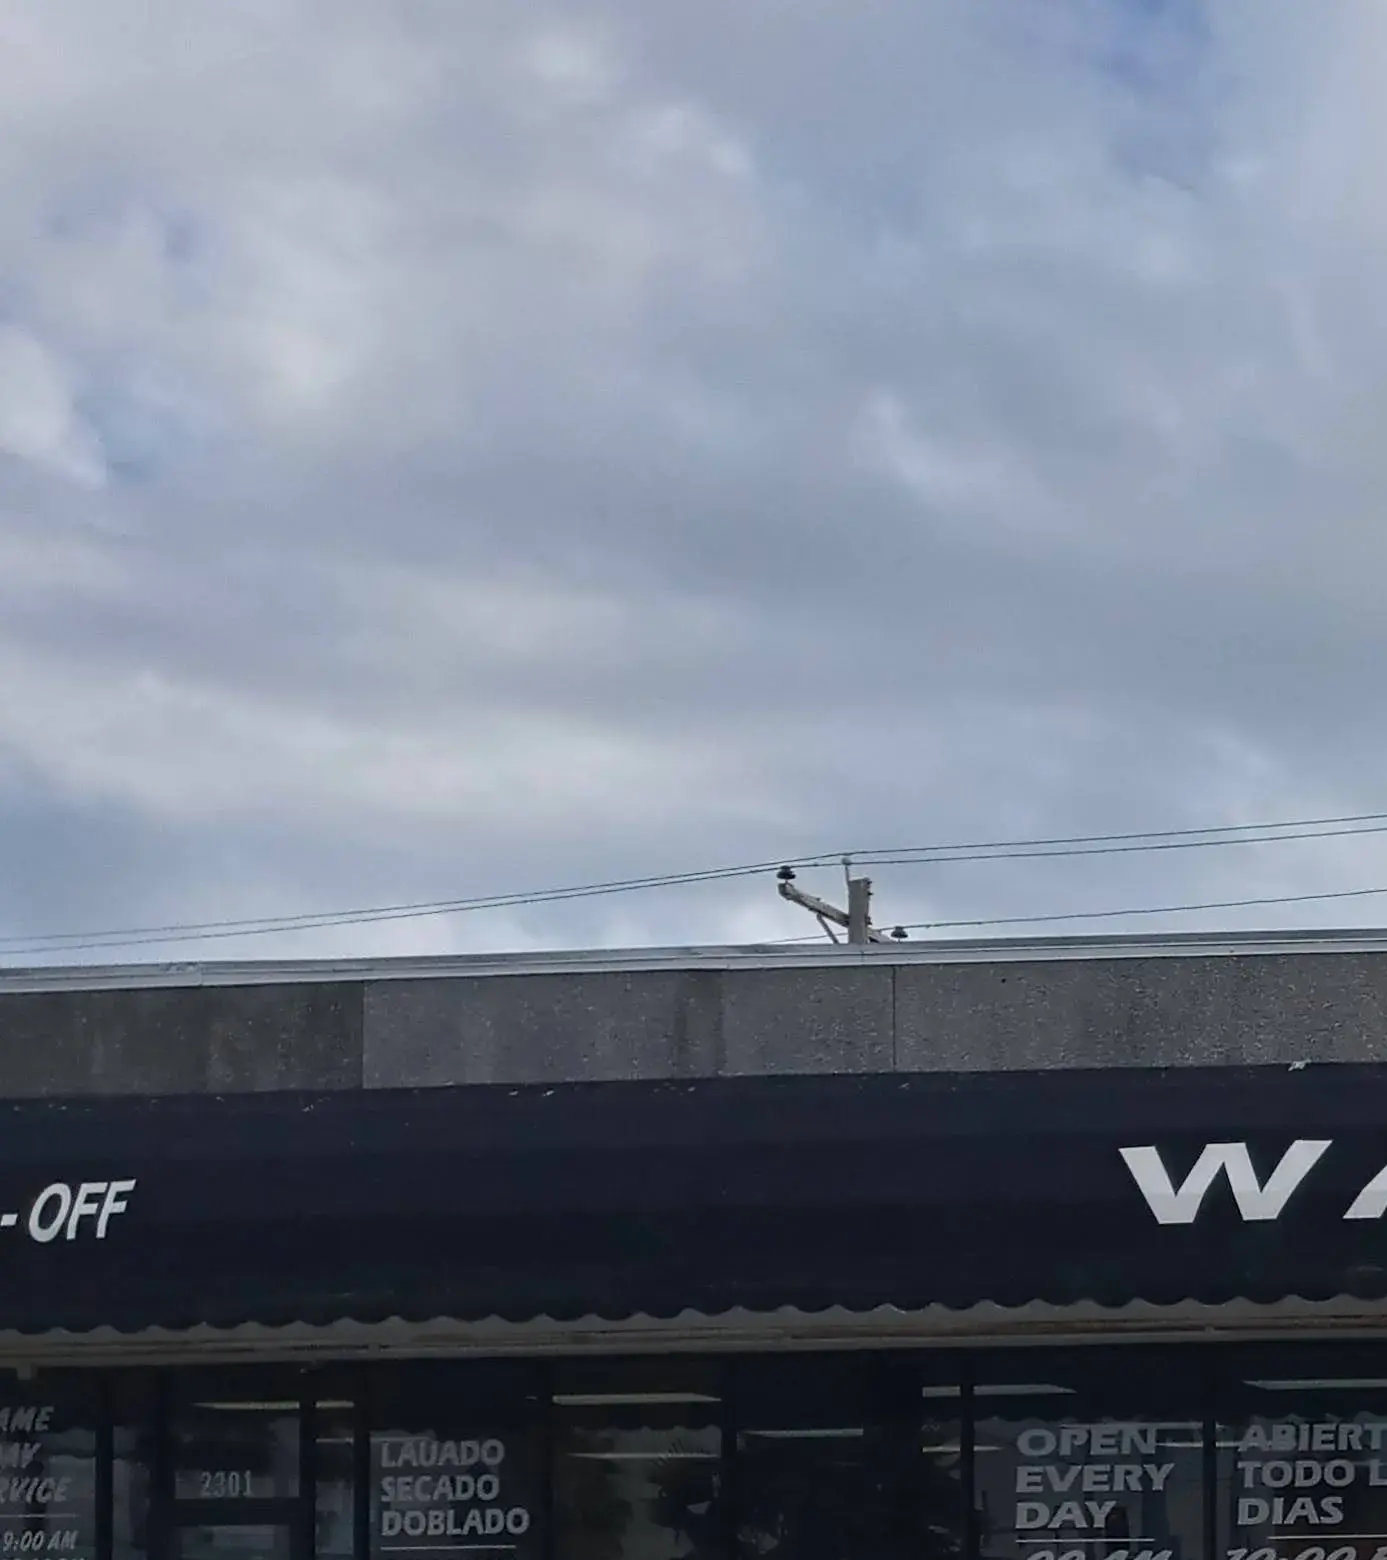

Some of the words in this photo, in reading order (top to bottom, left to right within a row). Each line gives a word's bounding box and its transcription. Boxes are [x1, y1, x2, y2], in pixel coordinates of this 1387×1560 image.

[29, 1178, 136, 1242] OFF
[1016, 1427, 1157, 1457] OPEN
[201, 1469, 253, 1497] 2301
[381, 1475, 500, 1502] SECADO
[1016, 1463, 1175, 1493] EVERY
[1238, 1458, 1356, 1489] TODO
[381, 1507, 530, 1537] DOBLADO
[1016, 1500, 1118, 1530] DAY
[1238, 1496, 1344, 1526] DIAS
[3, 1531, 45, 1551] 9:00
[47, 1530, 79, 1550] AM
